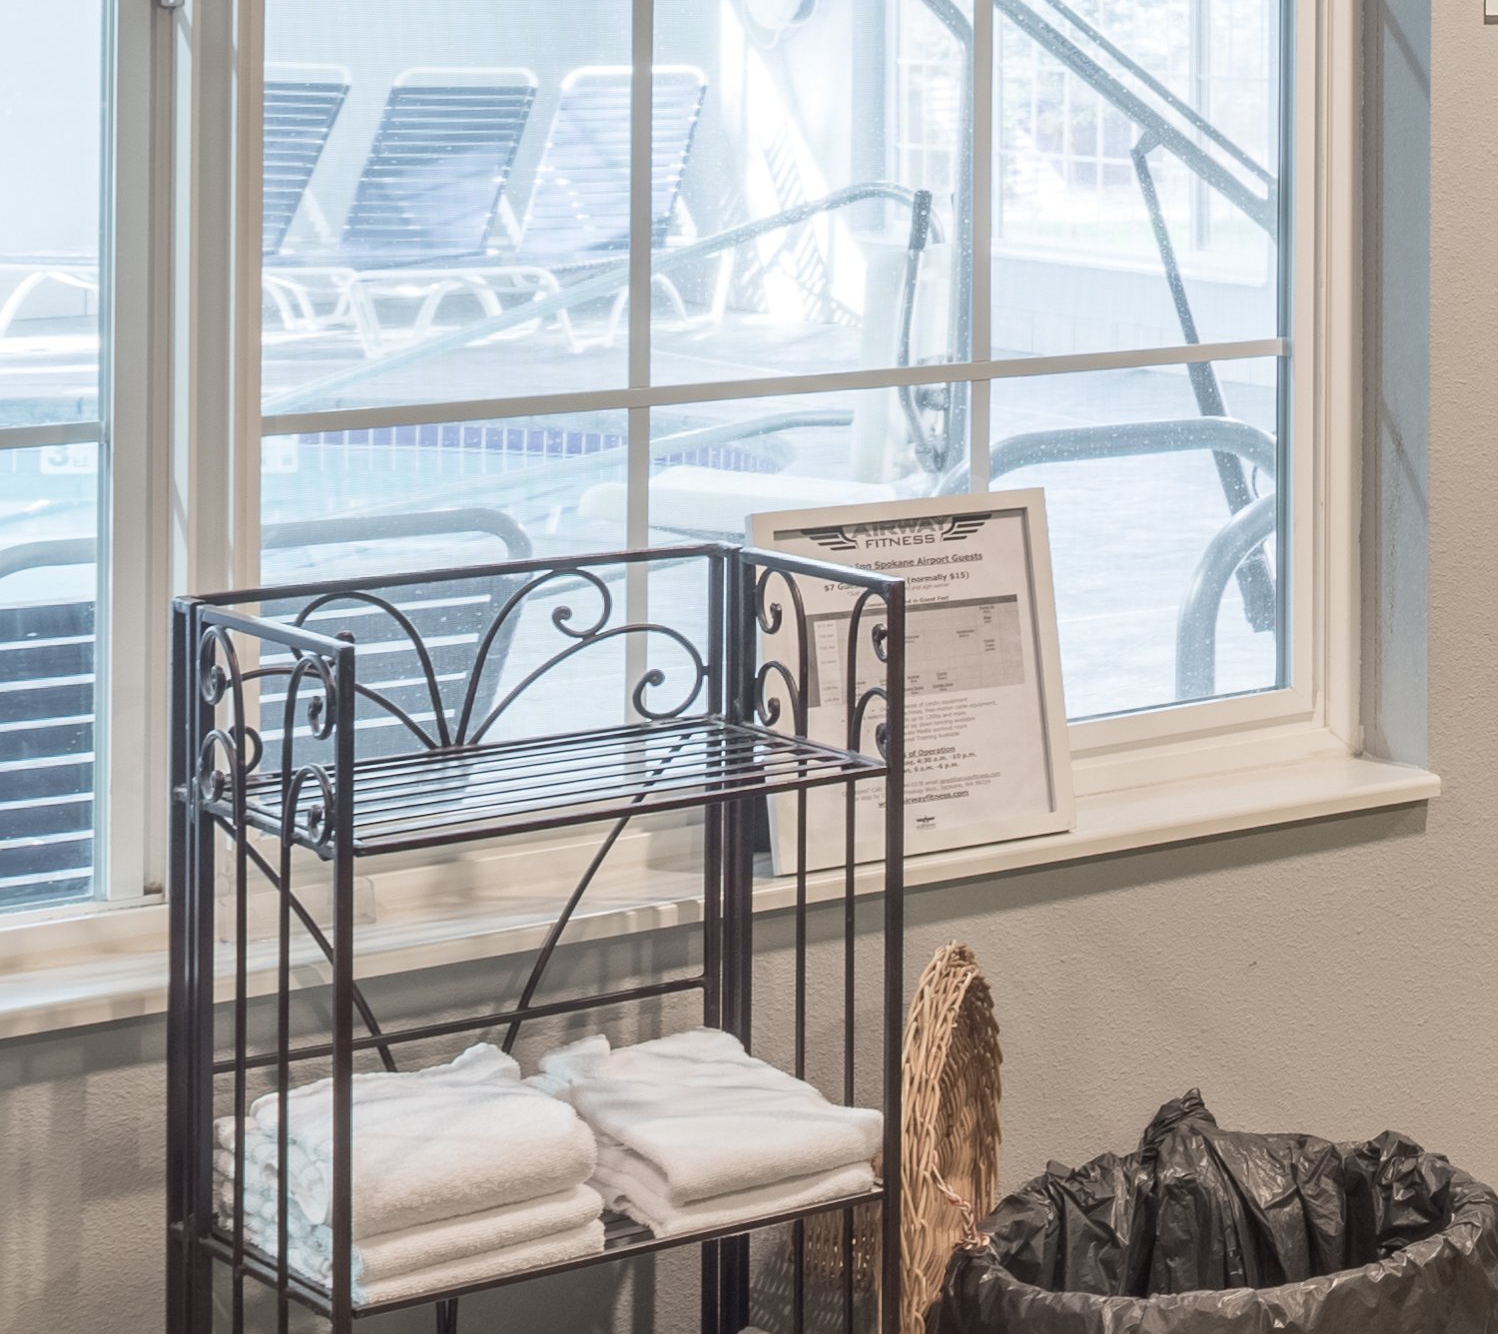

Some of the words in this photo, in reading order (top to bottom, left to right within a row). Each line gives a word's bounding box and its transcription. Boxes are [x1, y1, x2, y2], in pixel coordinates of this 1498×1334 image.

[851, 515, 949, 538] AIRWAY
[864, 534, 936, 549] FITNESS
[874, 558, 915, 570] Spokane
[917, 556, 950, 567] Airport
[951, 552, 984, 562] Guests
